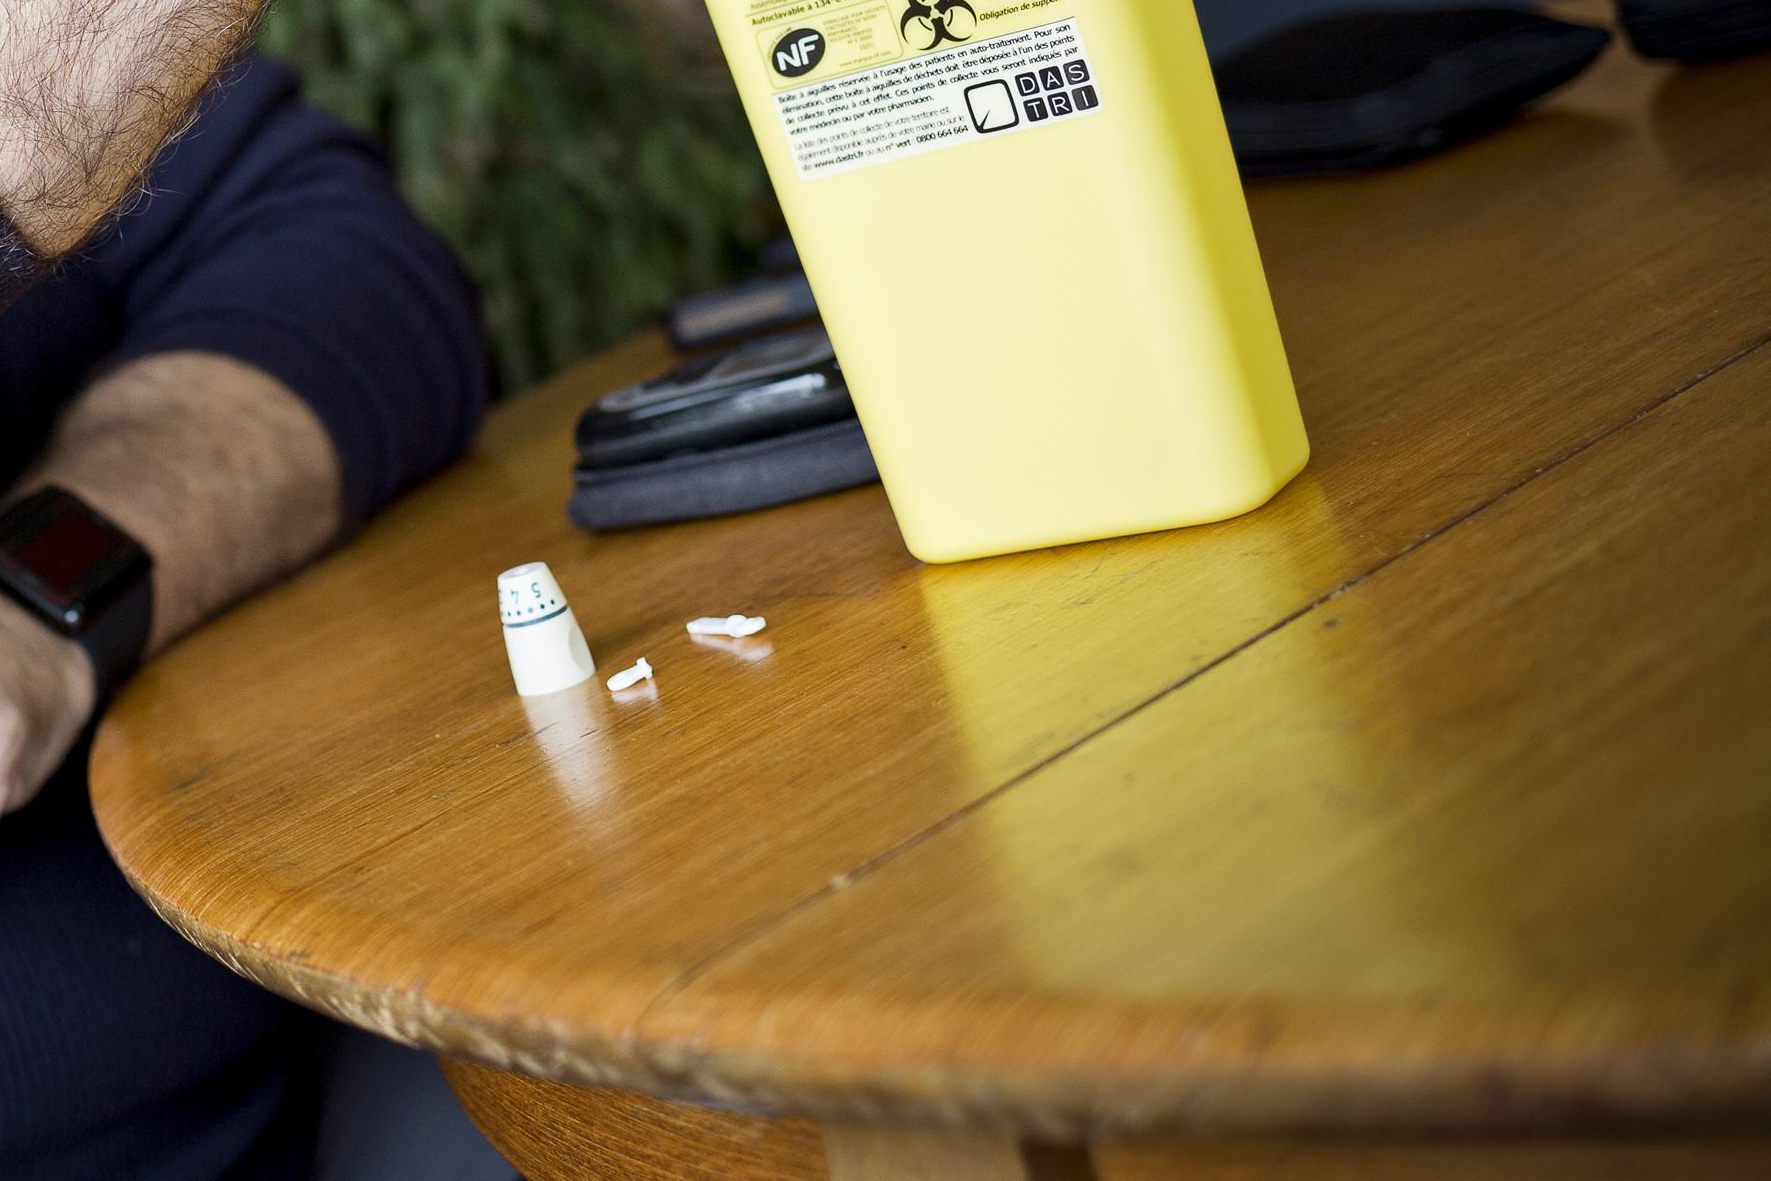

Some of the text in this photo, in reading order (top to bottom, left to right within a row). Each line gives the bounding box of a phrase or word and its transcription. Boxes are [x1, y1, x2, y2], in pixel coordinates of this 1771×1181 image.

[751, 5, 805, 25] Autoclavable
[979, 6, 1019, 21] Obligation
[1020, 2, 1030, 11] de
[775, 33, 819, 71] NF
[902, 75, 913, 84] de
[913, 68, 944, 80] déchets
[944, 63, 960, 73] doit
[978, 51, 1011, 64] déposée
[1034, 42, 1049, 51] des
[1049, 35, 1075, 49] points
[908, 62, 923, 70] des
[924, 53, 956, 67] patients
[1033, 28, 1052, 39] Pour
[1055, 24, 1071, 33] son
[894, 89, 909, 97] Ces
[911, 82, 935, 94] points
[949, 71, 978, 83] collecte
[980, 66, 999, 76] vous
[1001, 58, 1026, 70] seront
[1028, 50, 1062, 64] indiqués
[1064, 46, 1078, 57] par
[852, 112, 865, 121] par
[916, 132, 936, 143] 0800
[937, 128, 952, 138] 664
[953, 124, 969, 134] 664
